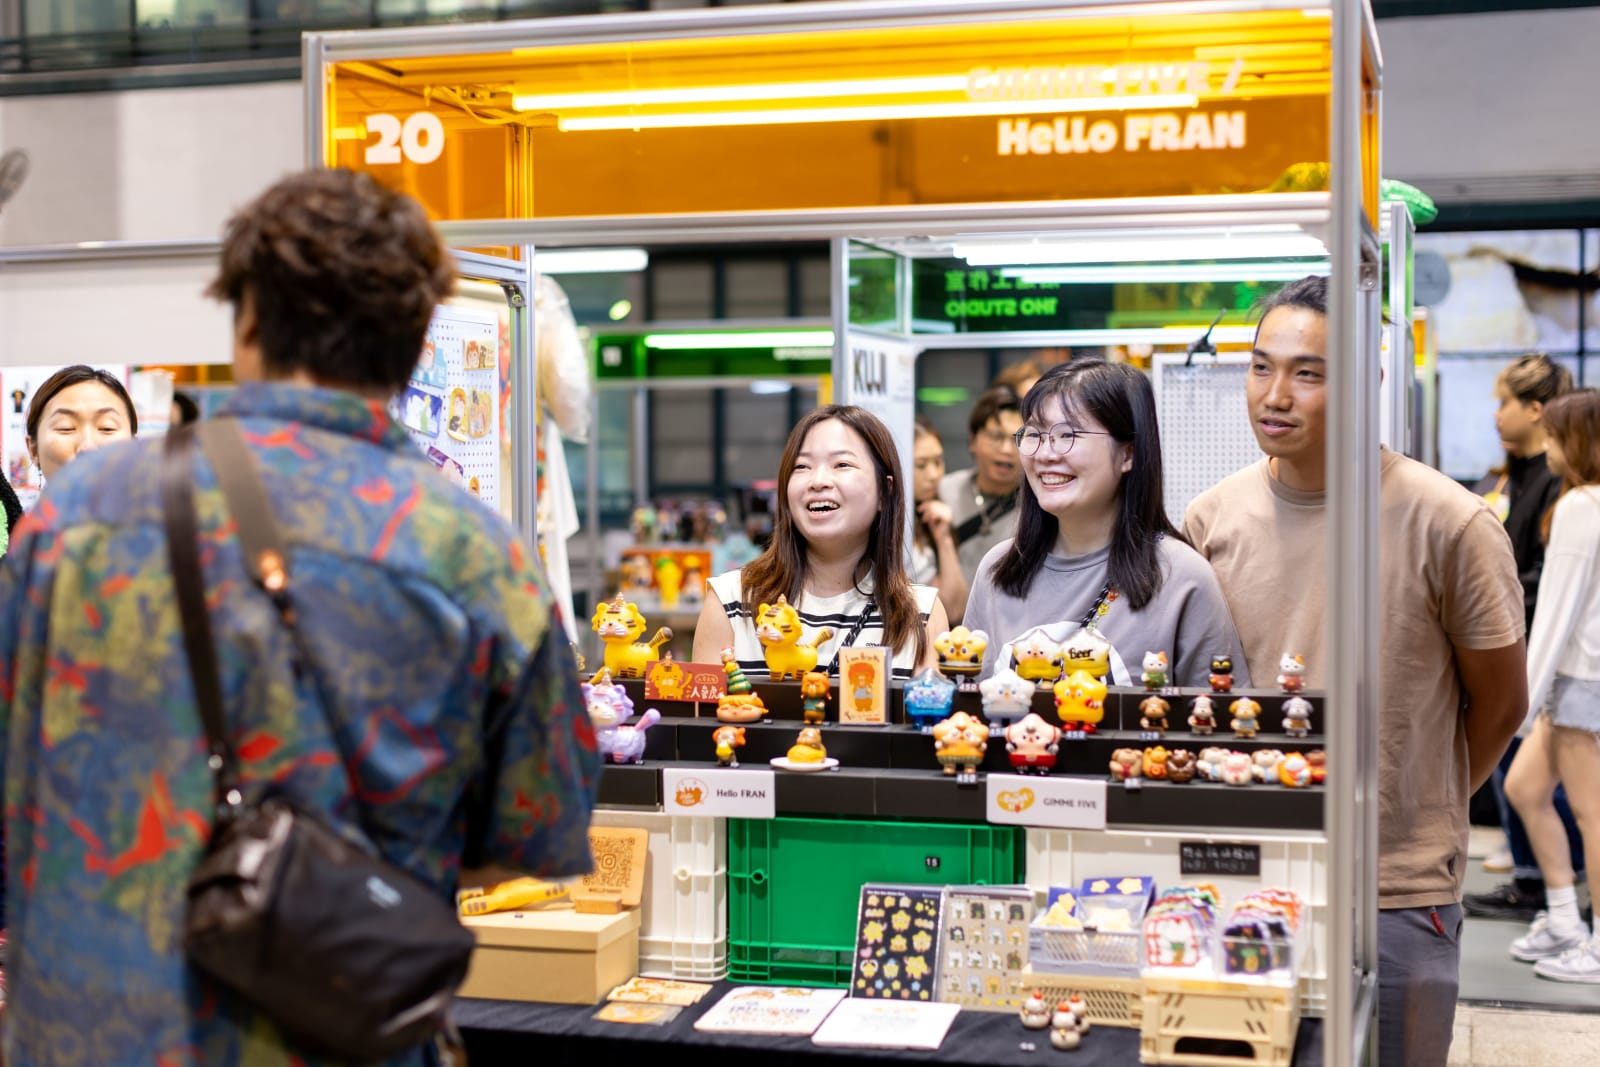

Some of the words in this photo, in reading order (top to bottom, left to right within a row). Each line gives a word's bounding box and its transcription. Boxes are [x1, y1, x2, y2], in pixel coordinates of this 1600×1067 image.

[967, 65, 1103, 99] GIMME
[1114, 60, 1209, 95] FIVE
[365, 111, 445, 164] 20
[997, 117, 1118, 155] Hello
[1124, 110, 1247, 151] FRAN
[716, 789, 738, 798] Hello
[740, 789, 766, 799] FRAN
[1043, 798, 1074, 808] GIMME
[1077, 799, 1097, 809] FIVE
